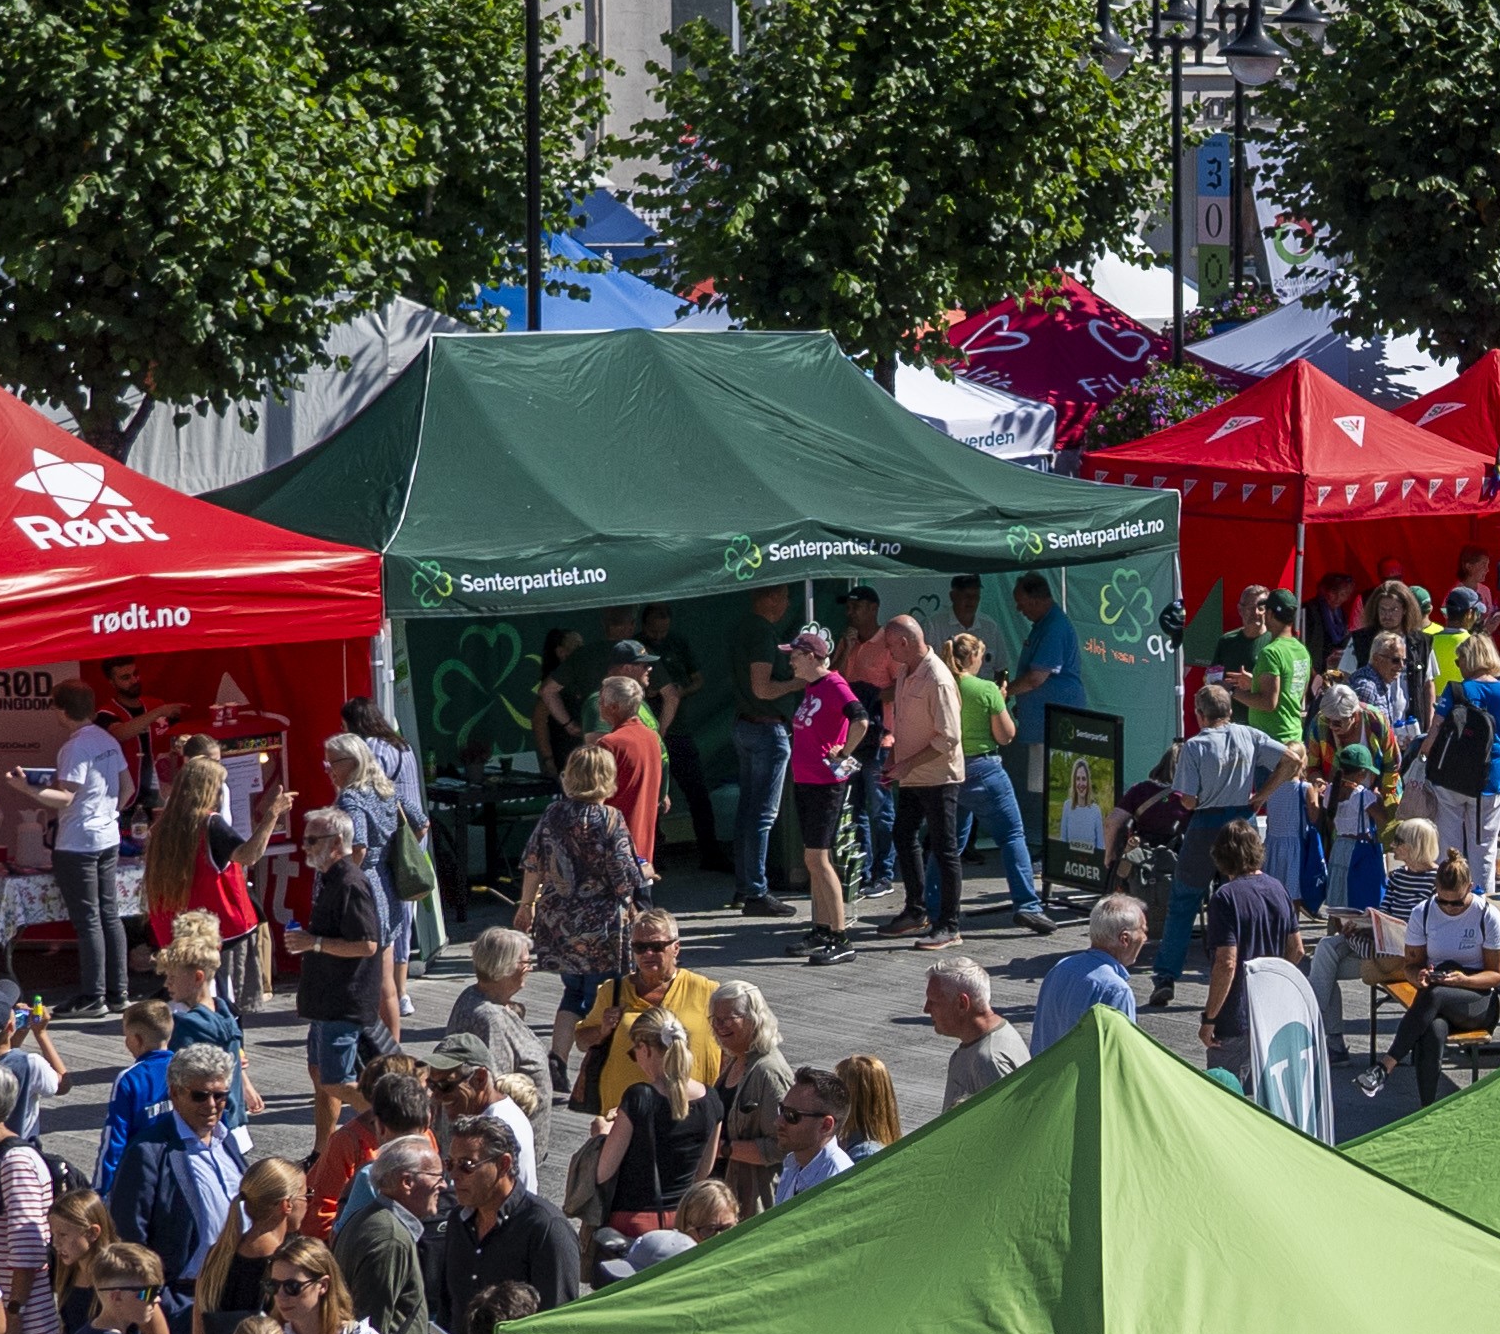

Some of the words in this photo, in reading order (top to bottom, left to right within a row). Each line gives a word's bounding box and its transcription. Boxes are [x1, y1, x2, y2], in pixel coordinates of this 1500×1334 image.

[13, 508, 170, 551] Rødt
[1047, 517, 1166, 551] Senterpartiet.no
[769, 536, 903, 563] Senterpartiet.no
[460, 564, 607, 594] Senterpartiet.no
[91, 603, 191, 635] rødt.no
[1064, 861, 1101, 881] AGDER
